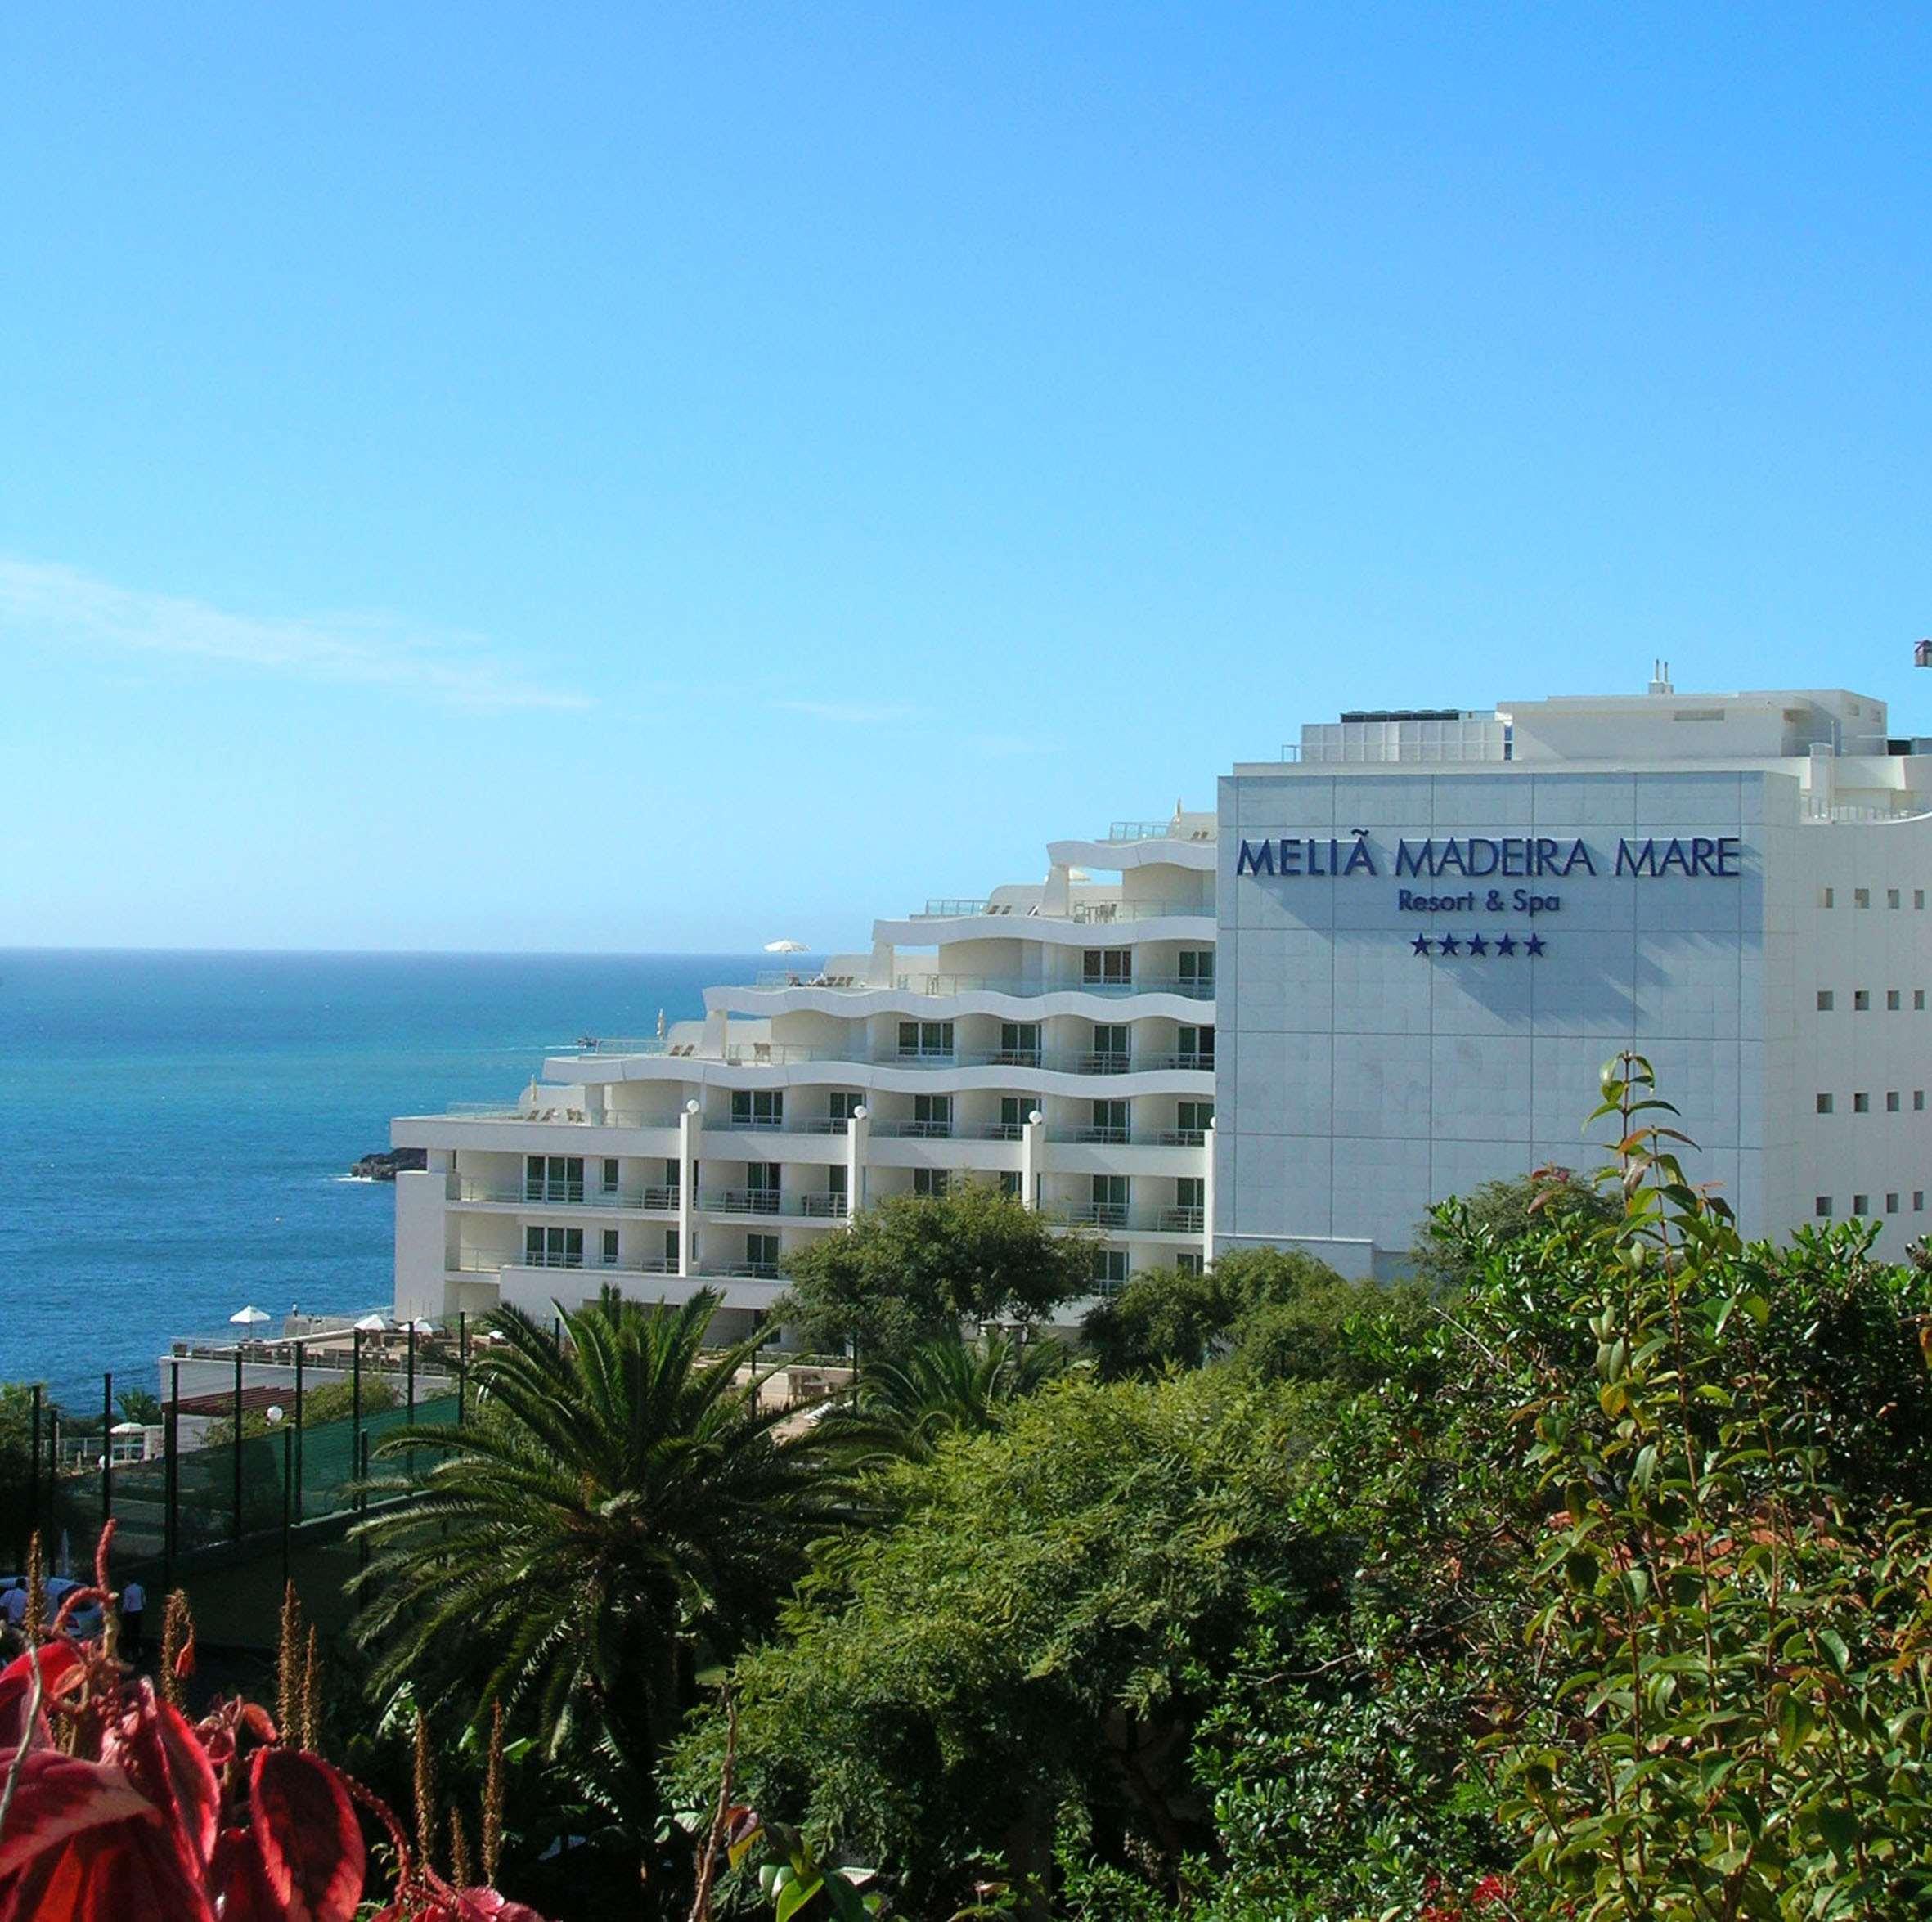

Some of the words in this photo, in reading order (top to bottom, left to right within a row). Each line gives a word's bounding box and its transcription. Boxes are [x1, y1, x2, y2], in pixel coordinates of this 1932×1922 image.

[1236, 829, 1377, 876] MELIÃ
[1395, 838, 1596, 877] MADEIRA
[1615, 838, 1740, 877] MARE
[1398, 889, 1472, 911] Resort
[1486, 890, 1504, 911] &
[1514, 889, 1560, 917] Spa
